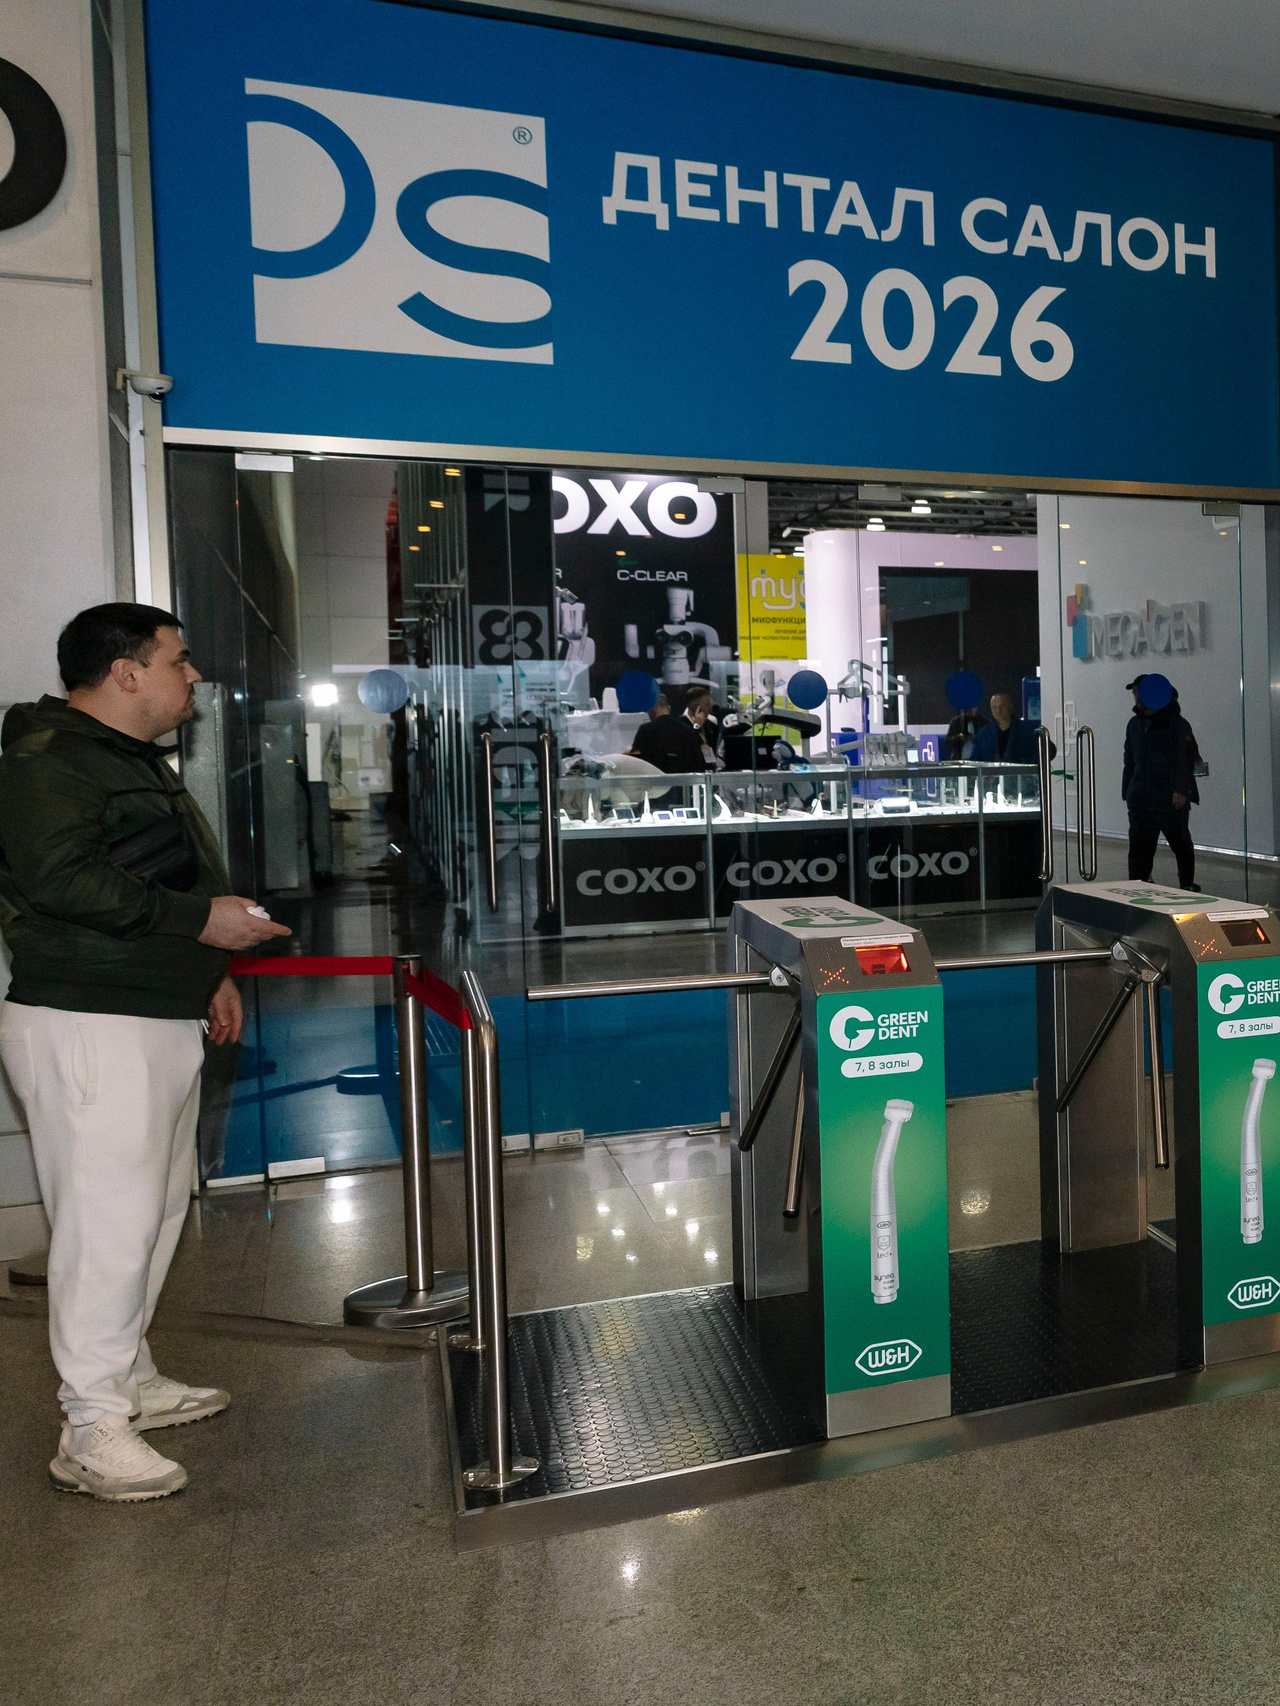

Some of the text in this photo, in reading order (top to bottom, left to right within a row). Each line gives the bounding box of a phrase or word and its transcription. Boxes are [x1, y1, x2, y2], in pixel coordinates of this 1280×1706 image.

[602, 151, 1217, 278] ДЕНТАЛ САЛОН
[787, 258, 1074, 382] 2026
[616, 570, 688, 582] C-CLEAR
[751, 569, 806, 610] my
[1247, 991, 1280, 1005] DENT
[877, 1011, 928, 1026] GREEN
[878, 1025, 919, 1040] DENT
[1228, 1022, 1273, 1034] 7, 8 залы
[855, 1059, 910, 1072] 7, 8 залы
[1238, 1282, 1272, 1302] W&H
[868, 1345, 910, 1368] W&H
